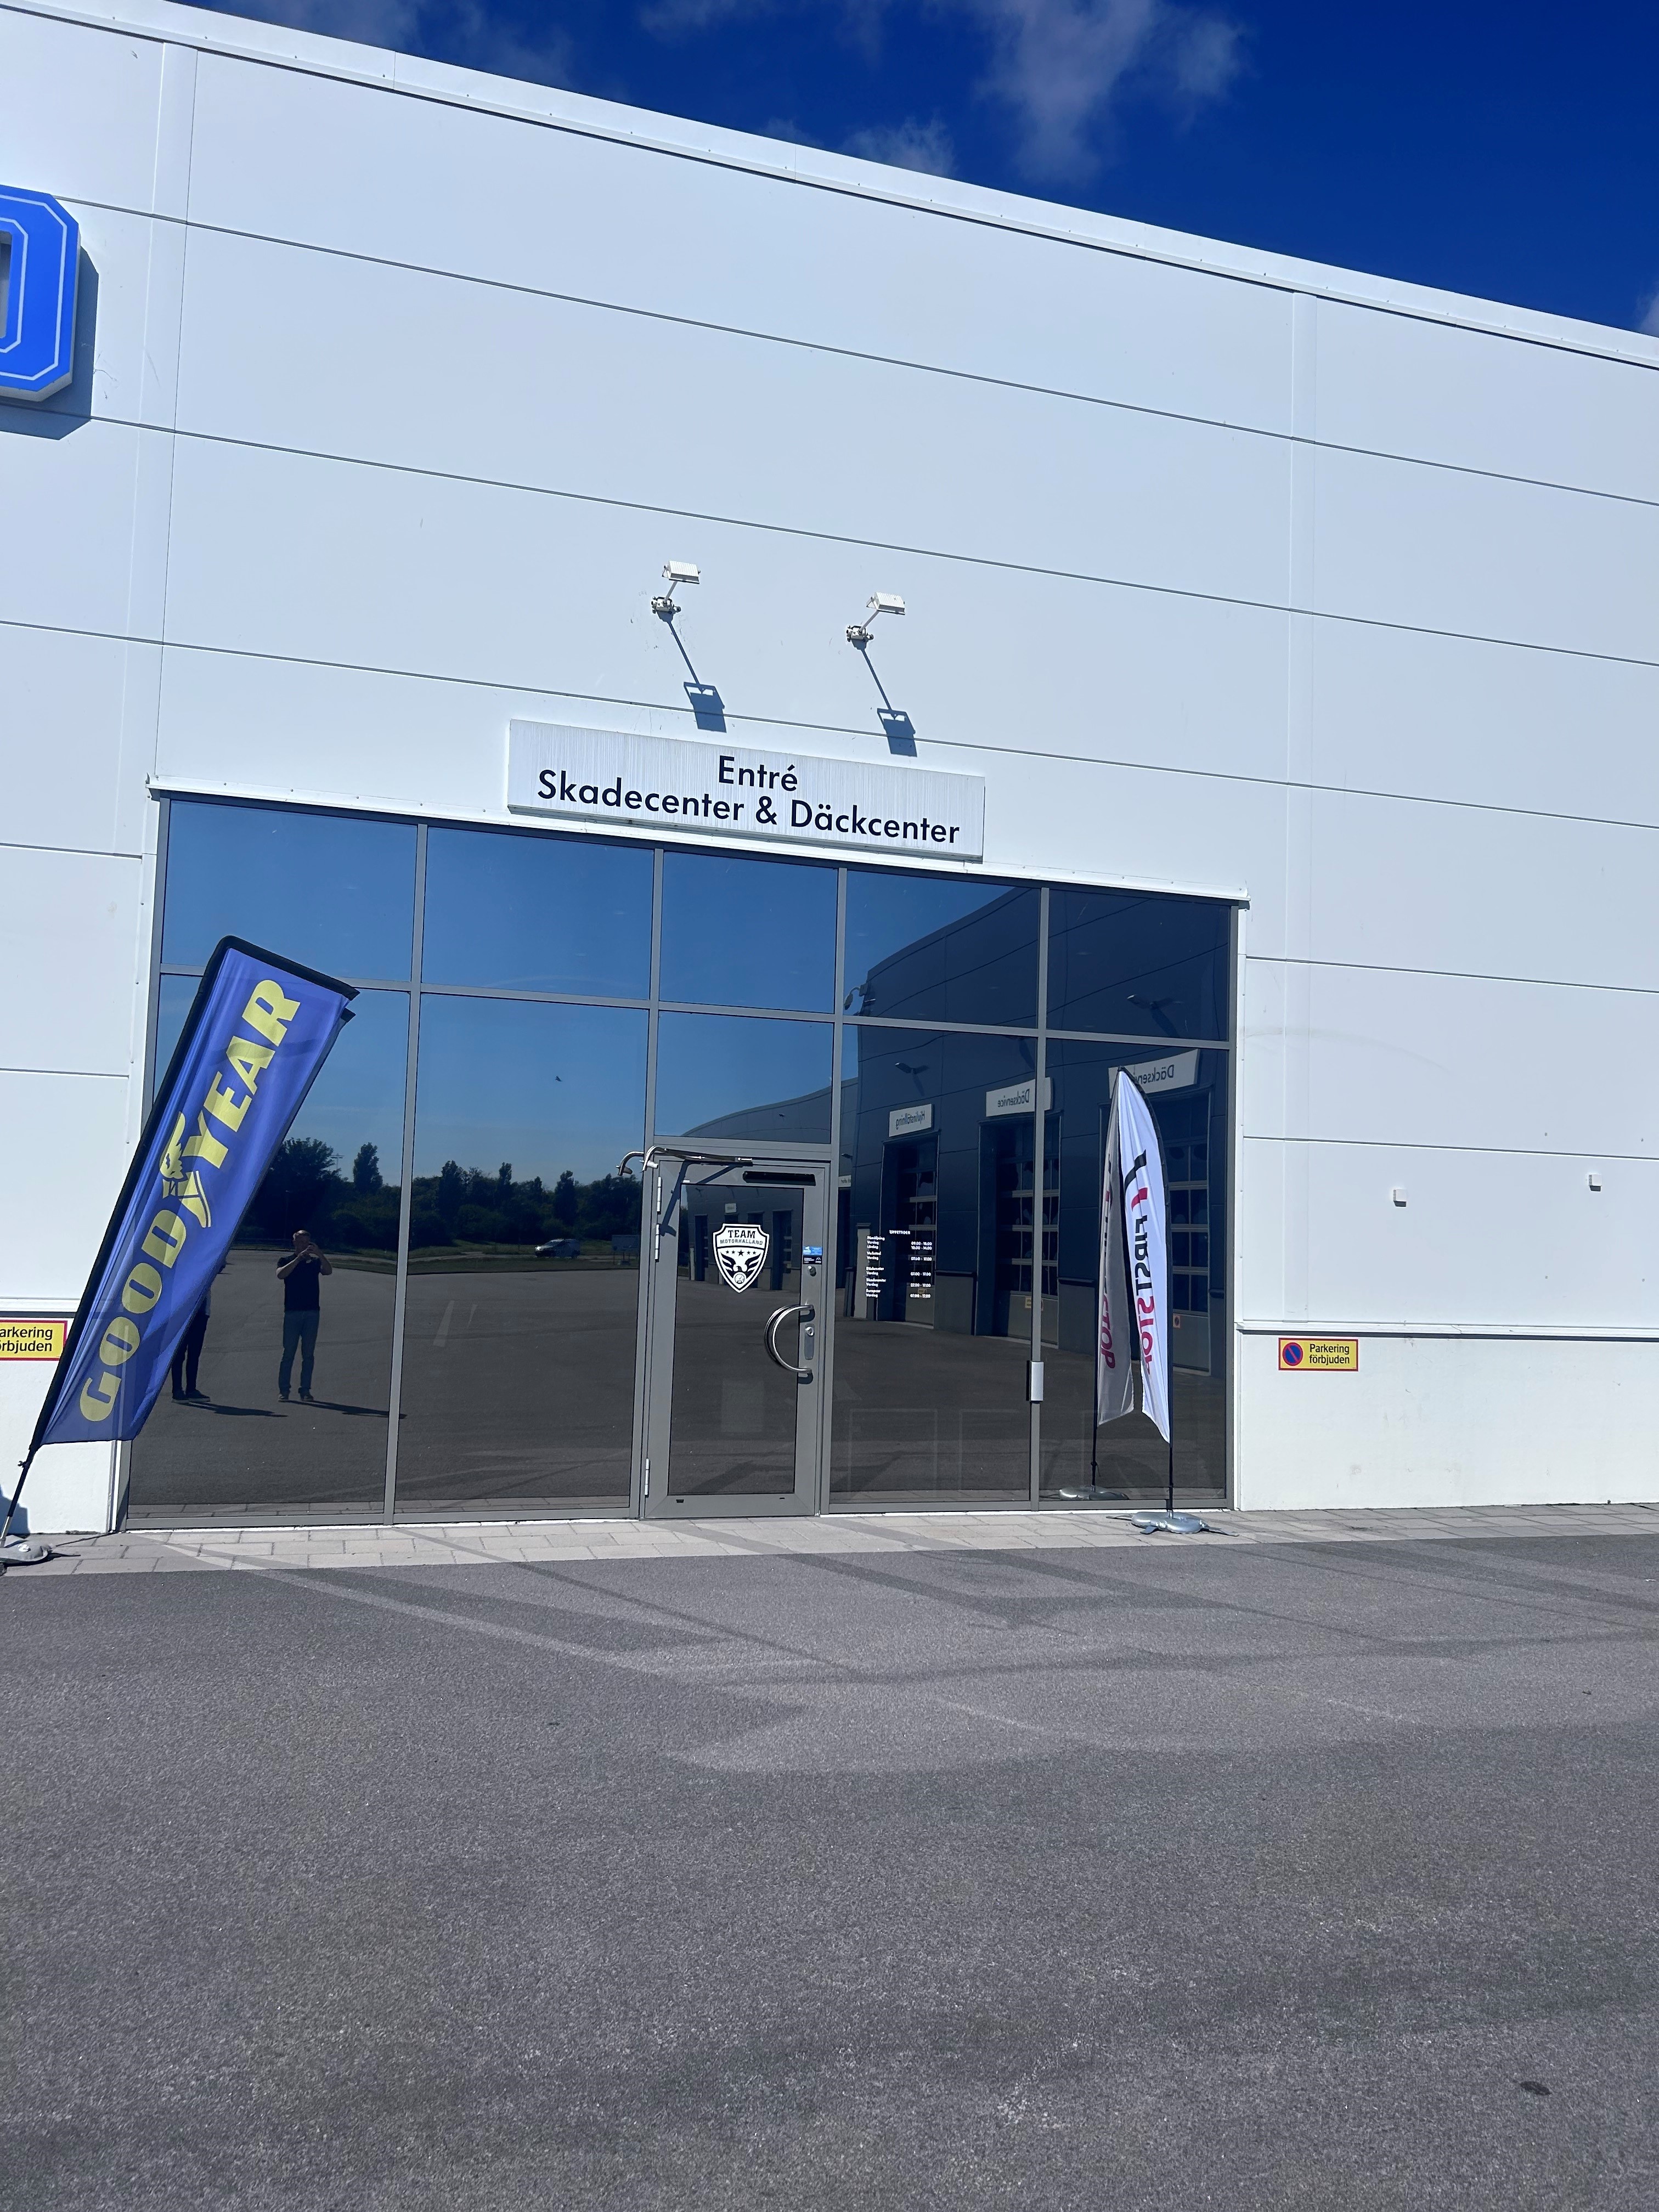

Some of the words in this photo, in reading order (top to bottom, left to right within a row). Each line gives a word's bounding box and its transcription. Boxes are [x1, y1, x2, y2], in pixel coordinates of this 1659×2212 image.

[718, 755, 798, 792] Entré
[538, 769, 745, 821] Skadecenter
[755, 795, 778, 825] &
[791, 800, 960, 844] Däckcenter
[80, 979, 301, 1422] GOODYEAR
[727, 1229, 756, 1239] TEAM
[0, 1327, 53, 1340] arkering
[0, 1340, 52, 1354] rbjuden
[1310, 1344, 1350, 1355] Parkering
[1309, 1355, 1350, 1365] förbjuden
